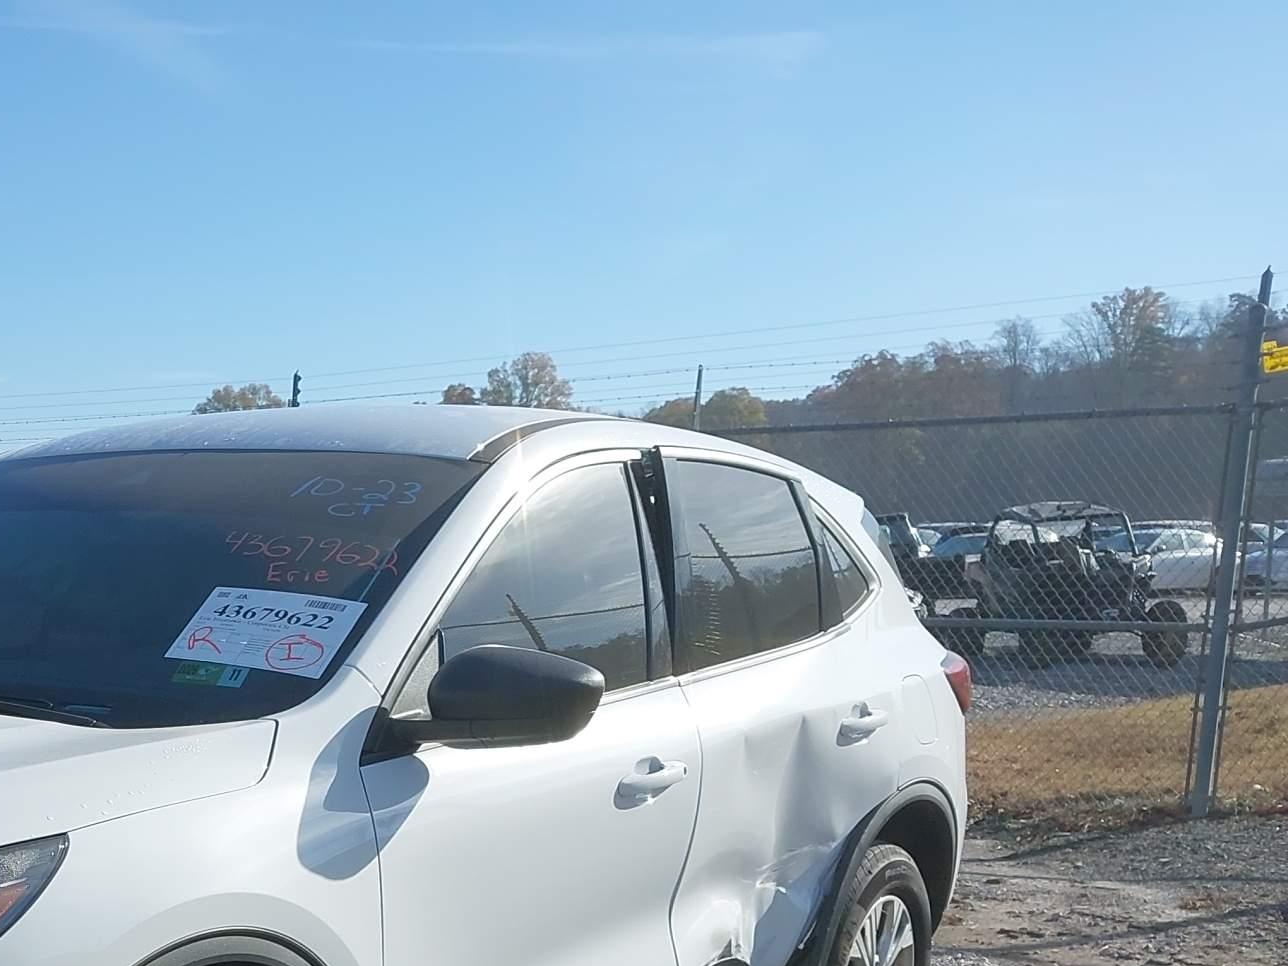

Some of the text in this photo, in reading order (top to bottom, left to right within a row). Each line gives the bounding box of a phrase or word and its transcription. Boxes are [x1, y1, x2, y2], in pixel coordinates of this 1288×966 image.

[225, 531, 399, 576] 43679622
[267, 562, 329, 582] Erie
[213, 603, 334, 630] 43679622
[188, 626, 222, 654] R
